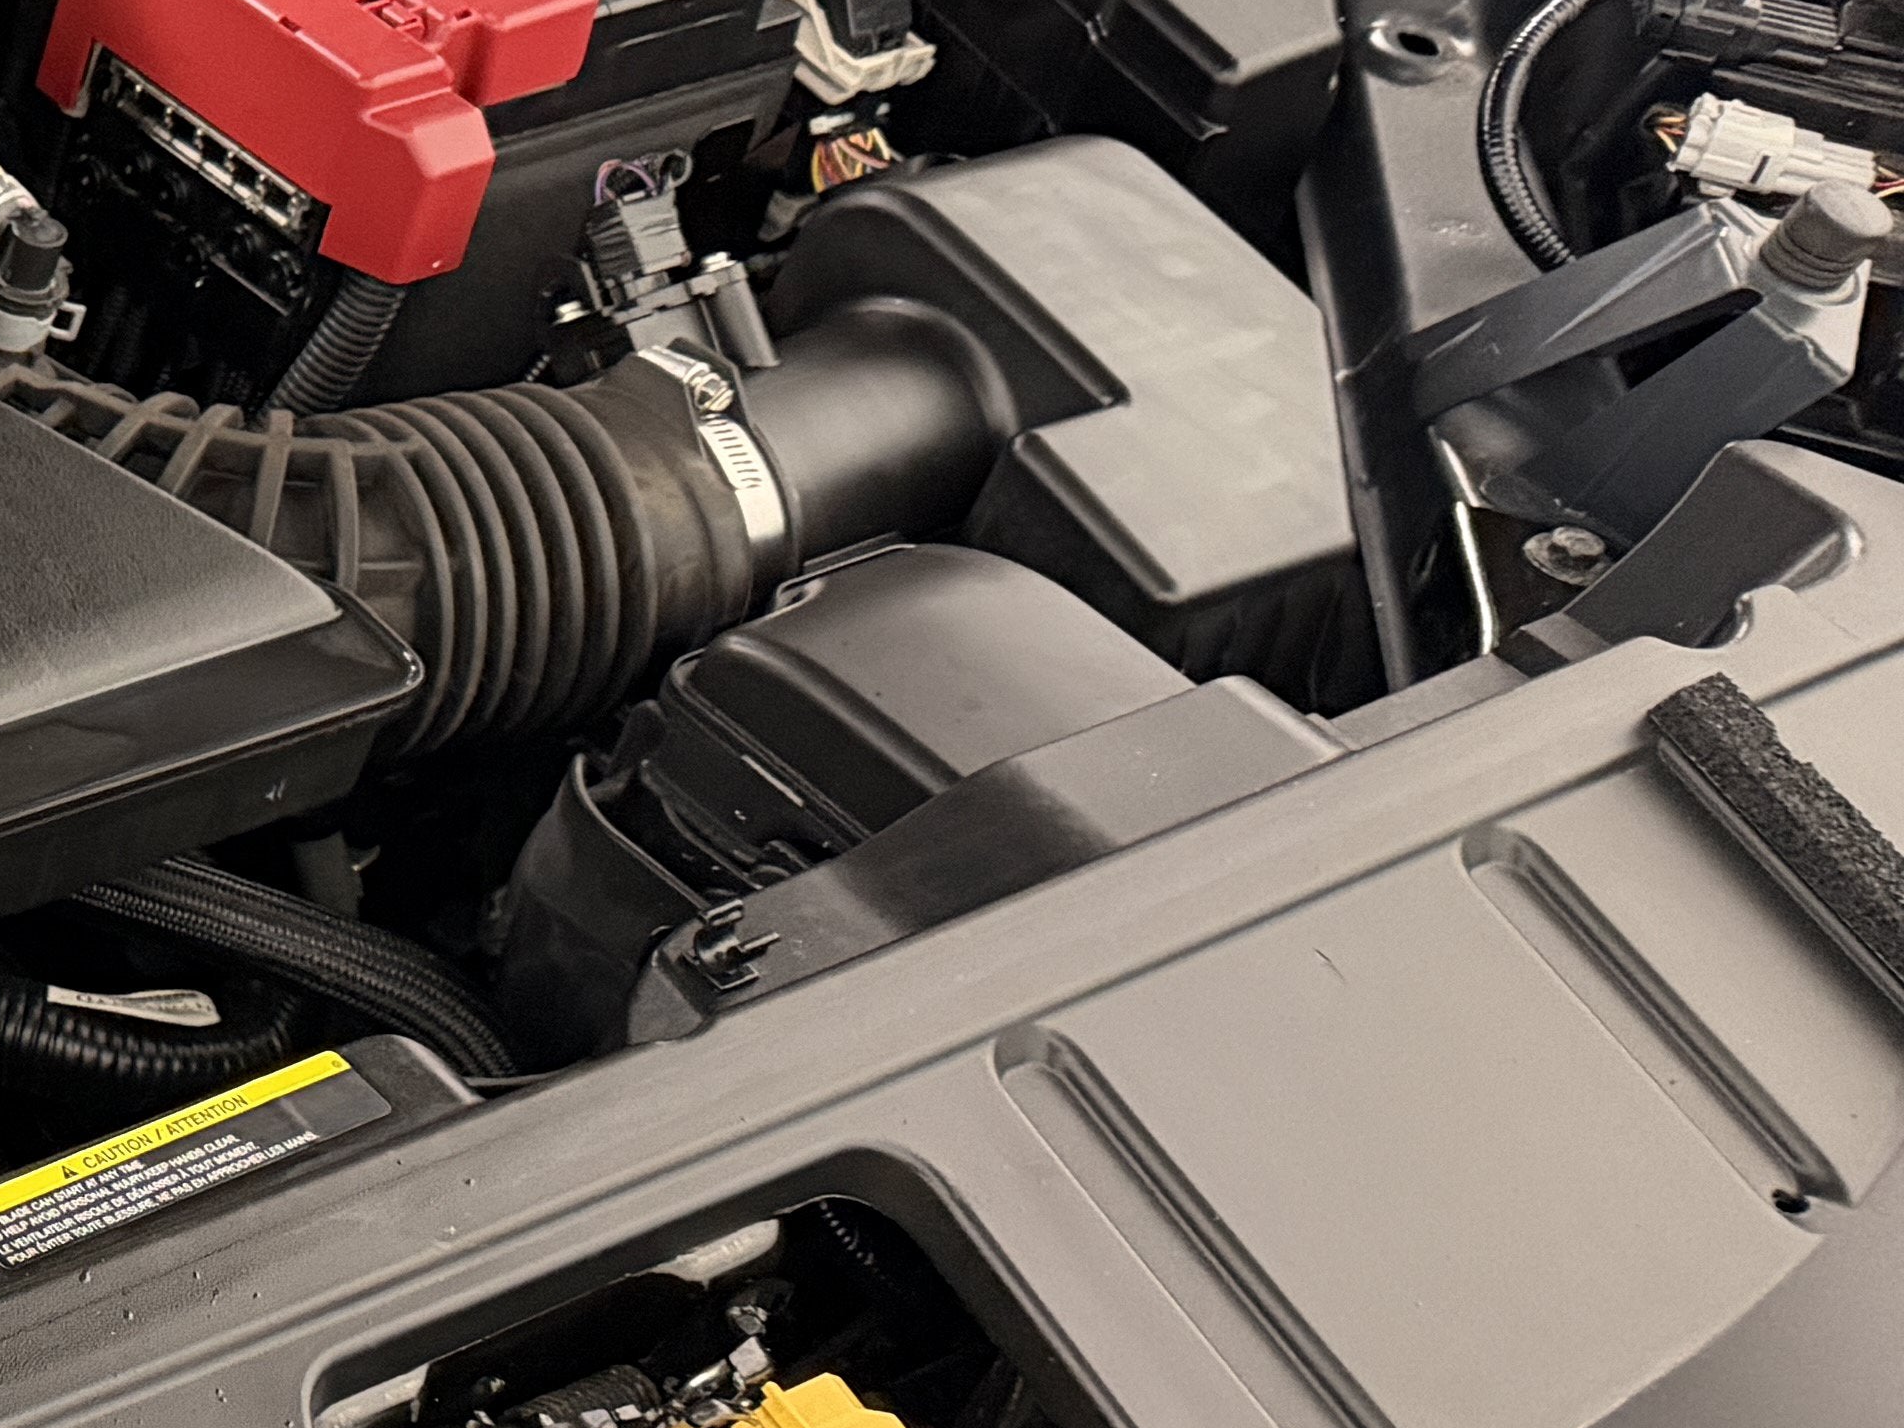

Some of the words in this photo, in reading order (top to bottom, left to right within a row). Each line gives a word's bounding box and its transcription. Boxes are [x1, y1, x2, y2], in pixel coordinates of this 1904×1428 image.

[82, 1133, 153, 1169] CAUTION
[166, 1094, 249, 1135] ATTENTION
[4, 1220, 29, 1239] HELP
[30, 1207, 60, 1228] AVOID
[60, 1185, 114, 1214] PERSONAL
[169, 1148, 206, 1169] HANDS
[7, 1247, 38, 1266] POUR
[72, 1219, 105, 1240] TOUTE
[157, 1190, 174, 1204] NE
[173, 1183, 194, 1198] PAS
[191, 1176, 208, 1192] EN
[206, 1150, 268, 1185] APPROCHER
[266, 1142, 286, 1159] LES
[12, 1217, 77, 1249] VENTILATEUR
[75, 1202, 113, 1226] RISQUE
[113, 1194, 130, 1209] DE
[189, 1159, 215, 1176] TOUT
[31, 1195, 54, 1212] CAN
[54, 1183, 85, 1203] START
[101, 1168, 121, 1186] ANY
